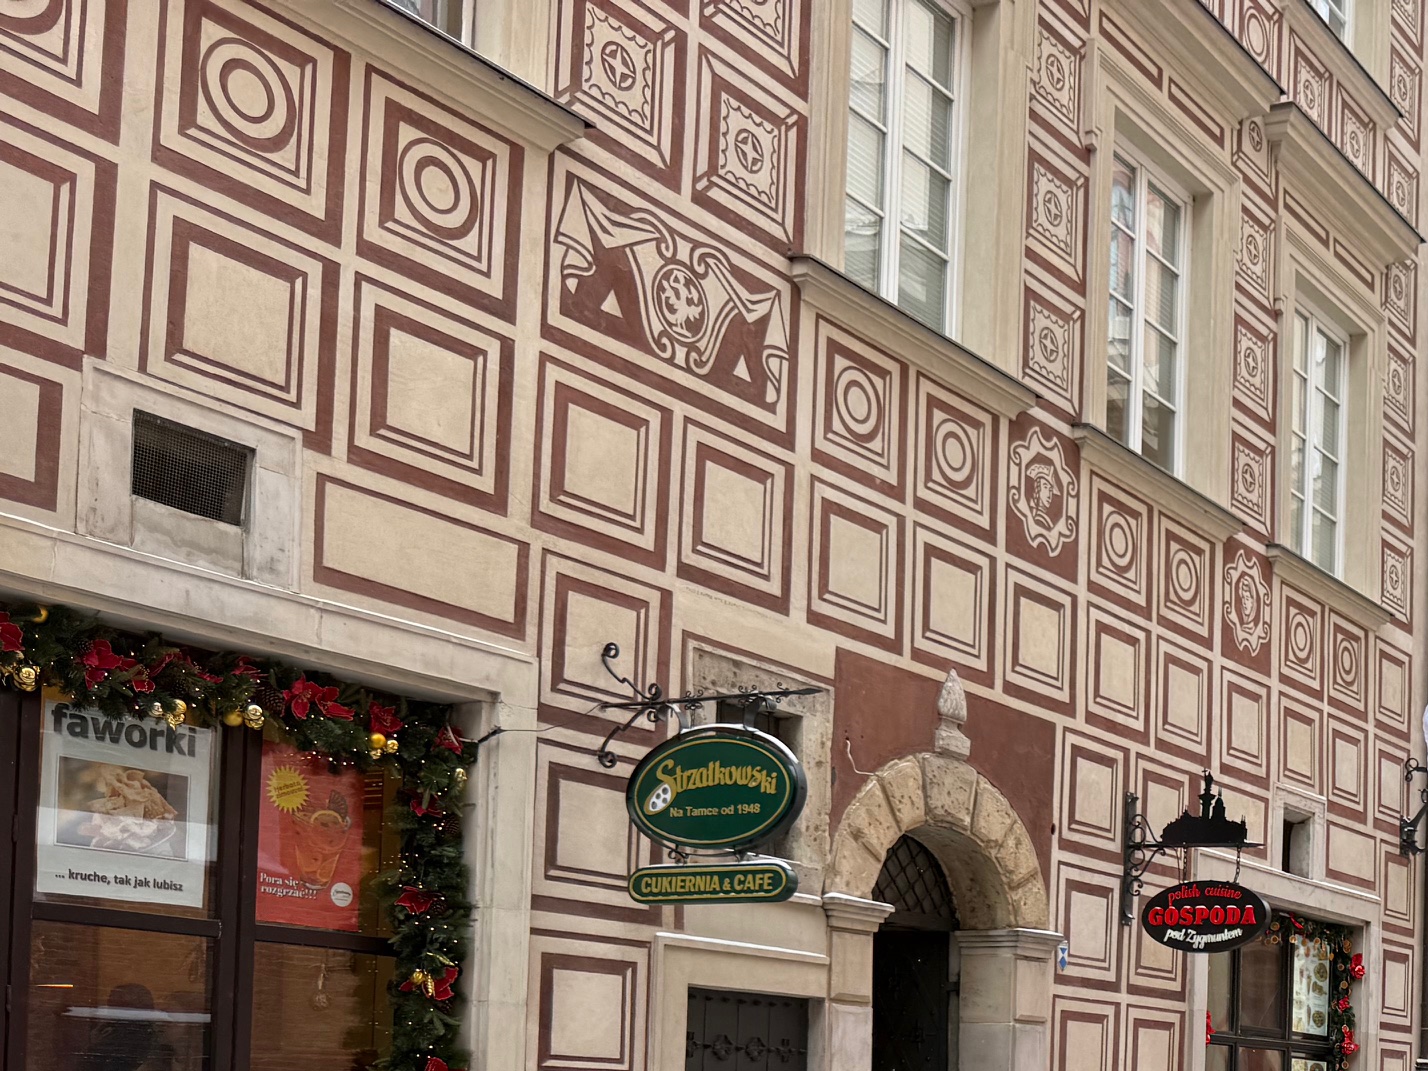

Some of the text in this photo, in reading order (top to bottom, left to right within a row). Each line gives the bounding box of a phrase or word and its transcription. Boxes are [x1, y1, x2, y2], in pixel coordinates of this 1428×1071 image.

[51, 702, 196, 758] faworki
[647, 759, 778, 807] Strzałkowski
[669, 803, 761, 818] Na Tamce od 1948
[68, 868, 111, 886] kruche,
[113, 874, 131, 886] tak
[133, 876, 151, 889] jak
[153, 878, 184, 892] lubisz
[260, 872, 299, 889] Pora się
[641, 873, 774, 894] CUKIERNIA & CAFE
[260, 885, 317, 899] rozgrzać!!!
[1168, 883, 1242, 906] polish cuisine
[1148, 905, 1257, 926] GOSPODA
[1163, 927, 1243, 949] pod Zygmuntem
